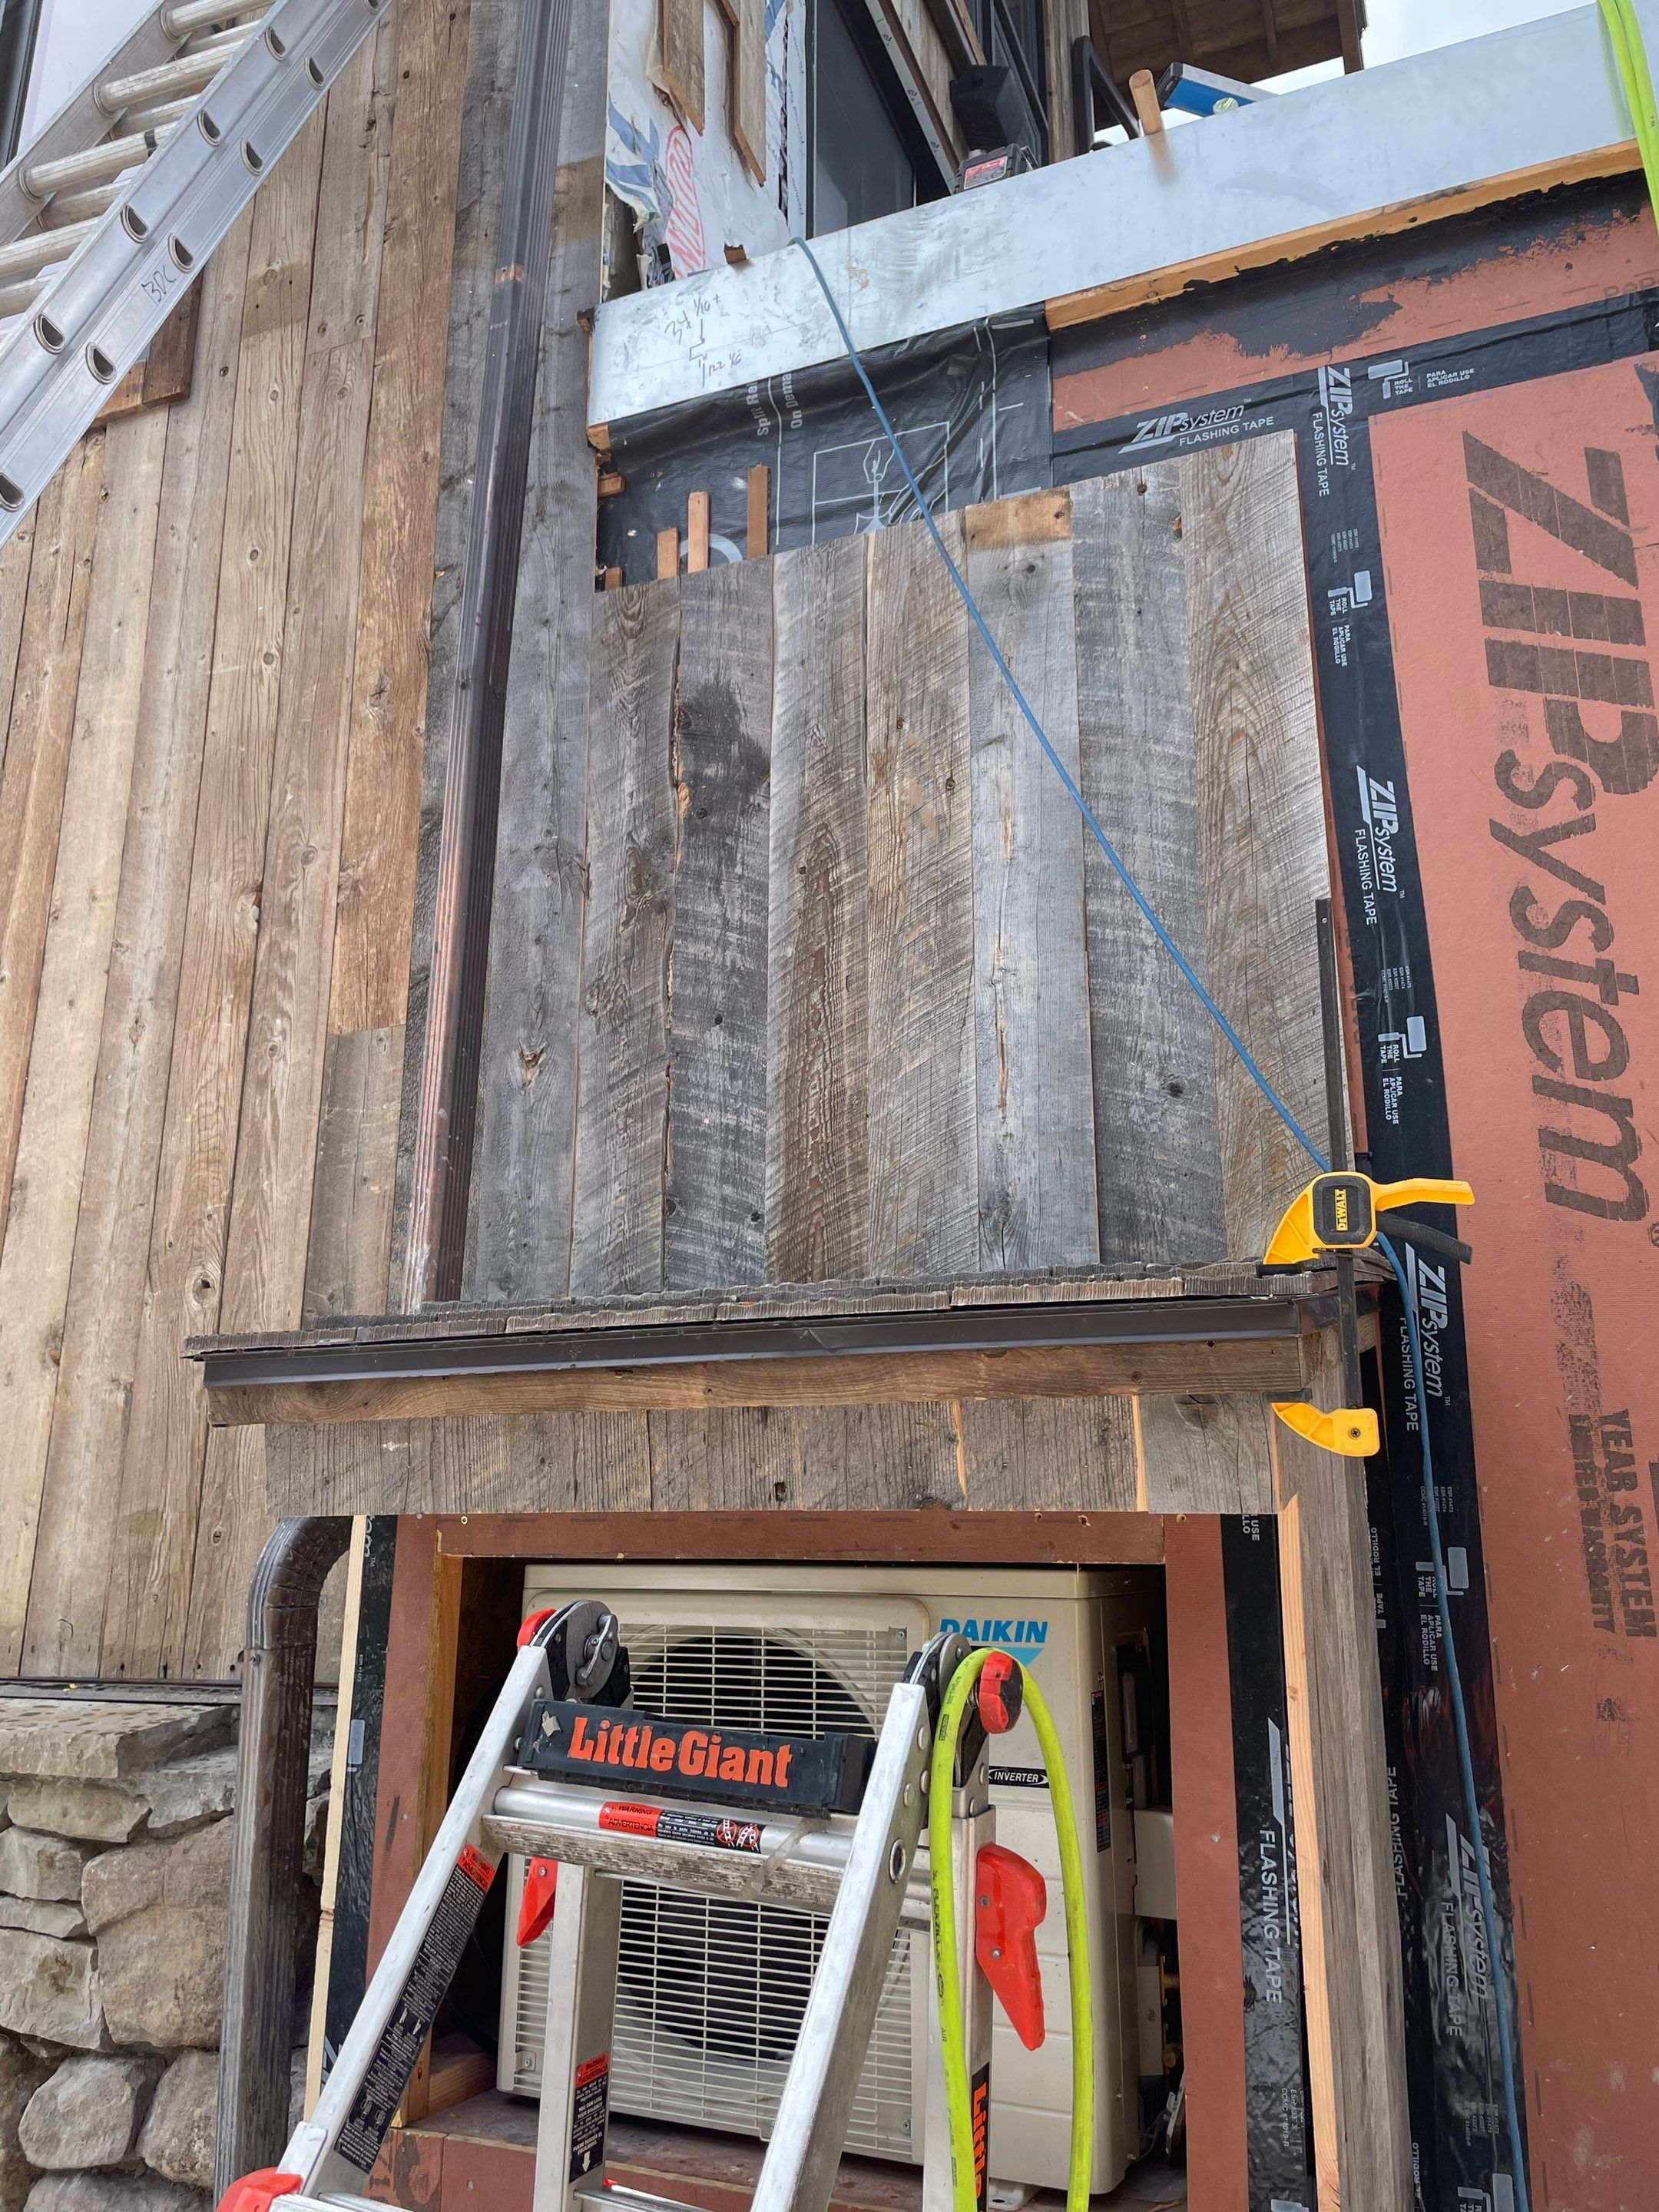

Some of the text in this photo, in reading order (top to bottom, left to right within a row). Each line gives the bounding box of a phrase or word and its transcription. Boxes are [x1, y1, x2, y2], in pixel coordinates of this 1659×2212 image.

[1427, 373, 1458, 383] APLICAR
[1439, 374, 1470, 386] RODILLO
[750, 407, 771, 436] Split
[790, 409, 803, 429] On
[1179, 416, 1274, 446] FLASHING TAPE
[1313, 412, 1330, 497] FLASHING TAPE
[1338, 627, 1346, 653] APLICAR
[1355, 828, 1377, 926] FLASHING TAPE
[1382, 1078, 1389, 1088] EL
[1389, 1077, 1398, 1108] APLICAR
[1384, 1088, 1392, 1121] RODILLO
[1405, 1393, 1419, 1432] TAPE
[1251, 1520, 1260, 1541] USE
[1599, 1409, 1657, 1637] YEAR SYSTEM
[1371, 1527, 1381, 1576] EL RODILLO
[940, 1619, 1048, 1643] DAIKIN
[1420, 1614, 1427, 1626] EL
[1427, 1614, 1437, 1651] APLICAR
[1422, 1627, 1430, 1665] RODILLO
[994, 1771, 1039, 1783] INVERTER
[608, 1817, 654, 1832] ADVERTENCIA
[618, 1805, 652, 1816] WARNING
[1260, 1829, 1282, 2004] FLASHING TAPE
[1441, 1901, 1462, 2037] FLASHING TAPE
